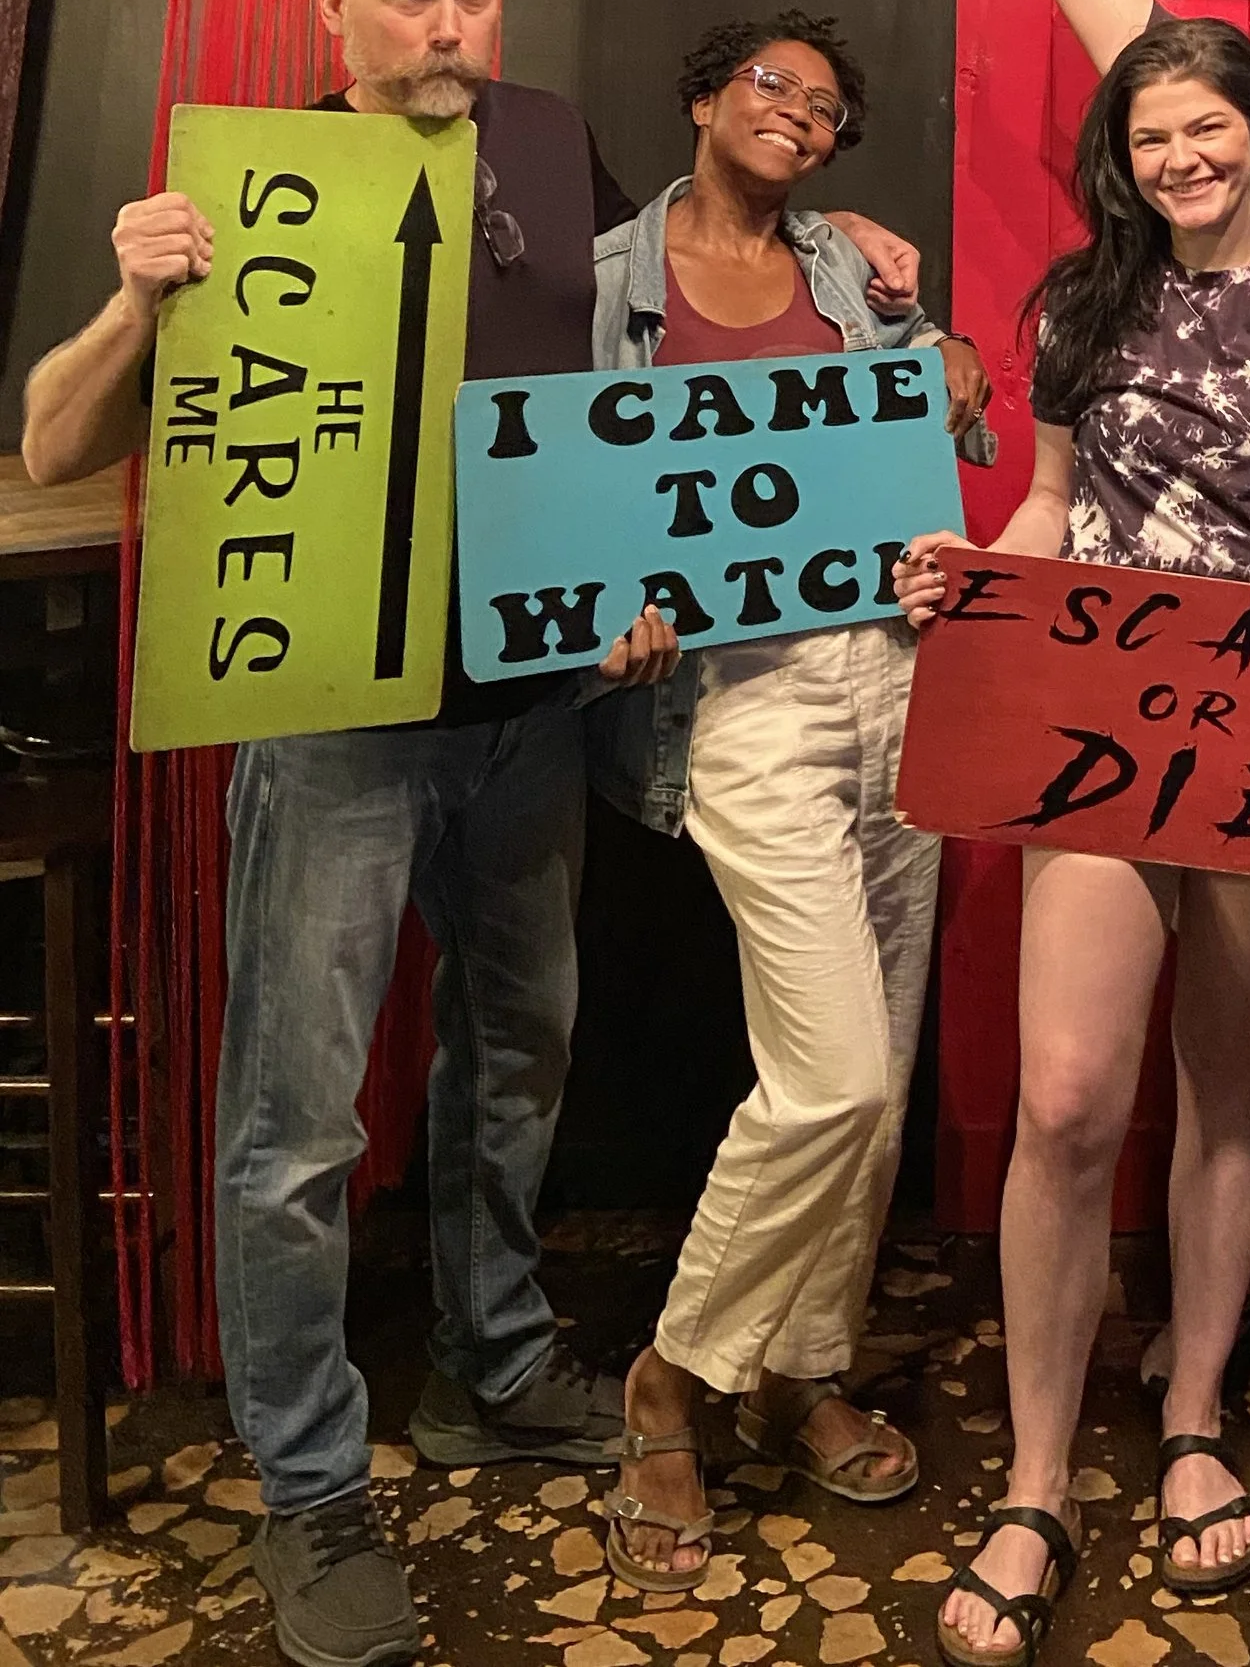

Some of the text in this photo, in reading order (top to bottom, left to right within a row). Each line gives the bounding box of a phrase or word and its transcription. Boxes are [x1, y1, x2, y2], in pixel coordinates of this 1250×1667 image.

[164, 375, 220, 468] ME
[208, 168, 319, 682] SCARES
[314, 380, 364, 453] HE
[487, 359, 929, 459] I CAME
[655, 463, 800, 538] TO
[1138, 683, 1236, 736] OR
